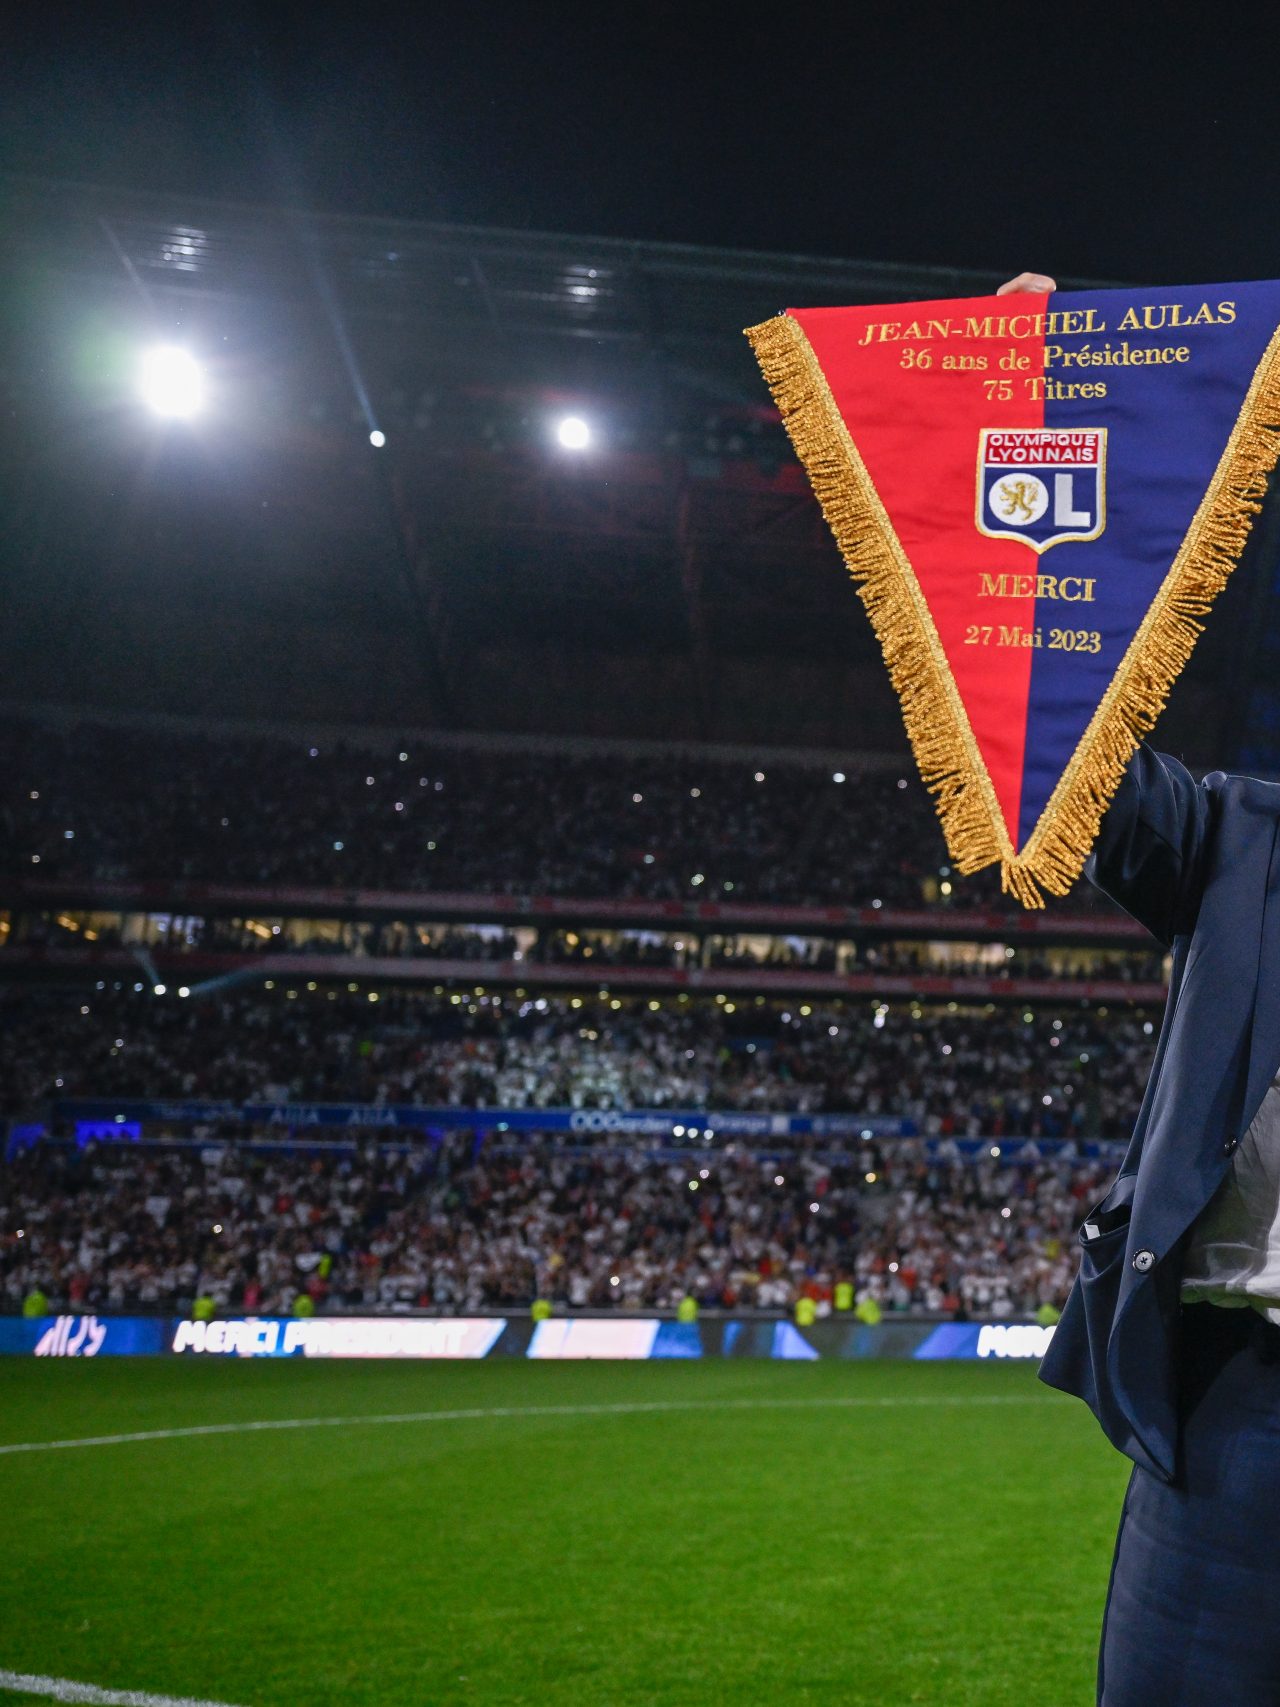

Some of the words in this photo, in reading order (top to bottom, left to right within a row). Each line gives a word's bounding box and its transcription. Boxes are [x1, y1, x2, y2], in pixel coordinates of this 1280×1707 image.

[858, 308, 1105, 346] JEAN-MICHEL
[1117, 301, 1237, 331] AULAS
[899, 348, 932, 369] 36
[941, 352, 989, 370] ans
[999, 347, 1031, 370] de
[1043, 343, 1190, 368] Présidence
[983, 379, 1013, 401] 75
[1024, 376, 1107, 400] Titres
[989, 434, 1096, 447] OLYMPIQUE
[988, 448, 1094, 462] LYONNAIS
[977, 572, 1096, 602] MERCI
[964, 625, 994, 645] 27
[996, 626, 1043, 648] Mai
[1048, 628, 1102, 653] 2023
[173, 1320, 278, 1353] MERCI
